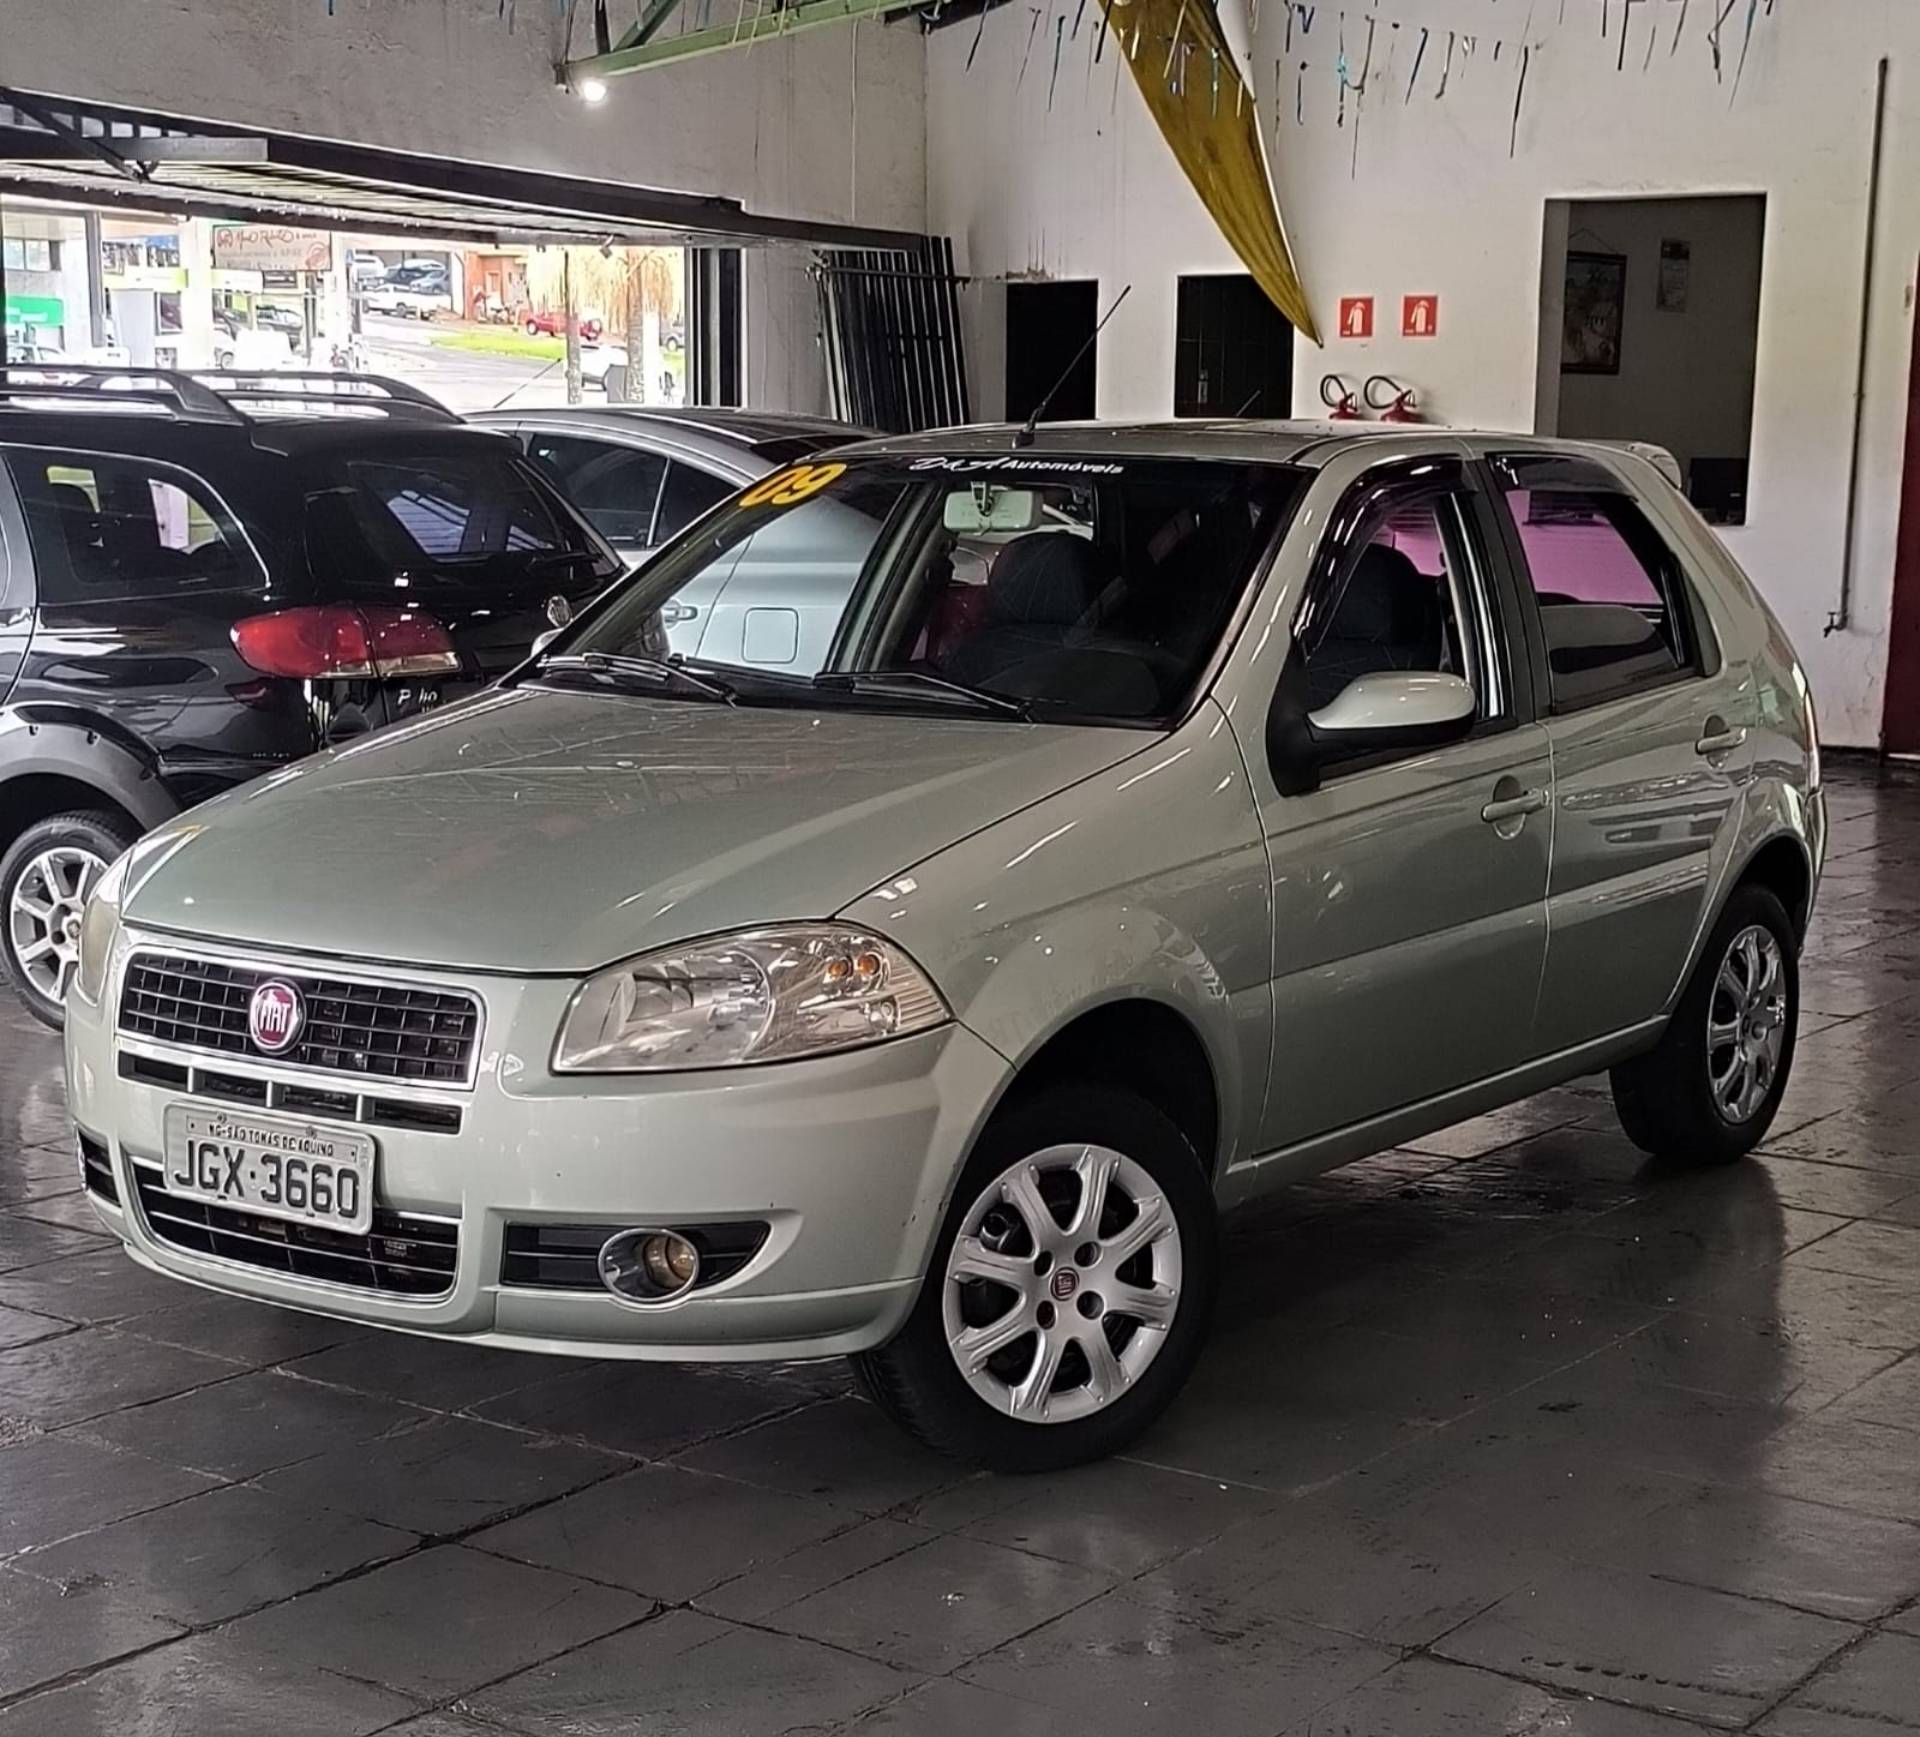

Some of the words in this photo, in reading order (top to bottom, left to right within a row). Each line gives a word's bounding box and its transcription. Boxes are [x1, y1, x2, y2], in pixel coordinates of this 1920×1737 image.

[738, 463, 848, 507] 09
[260, 998, 292, 1034] FIAT
[281, 1136, 297, 1151] DE
